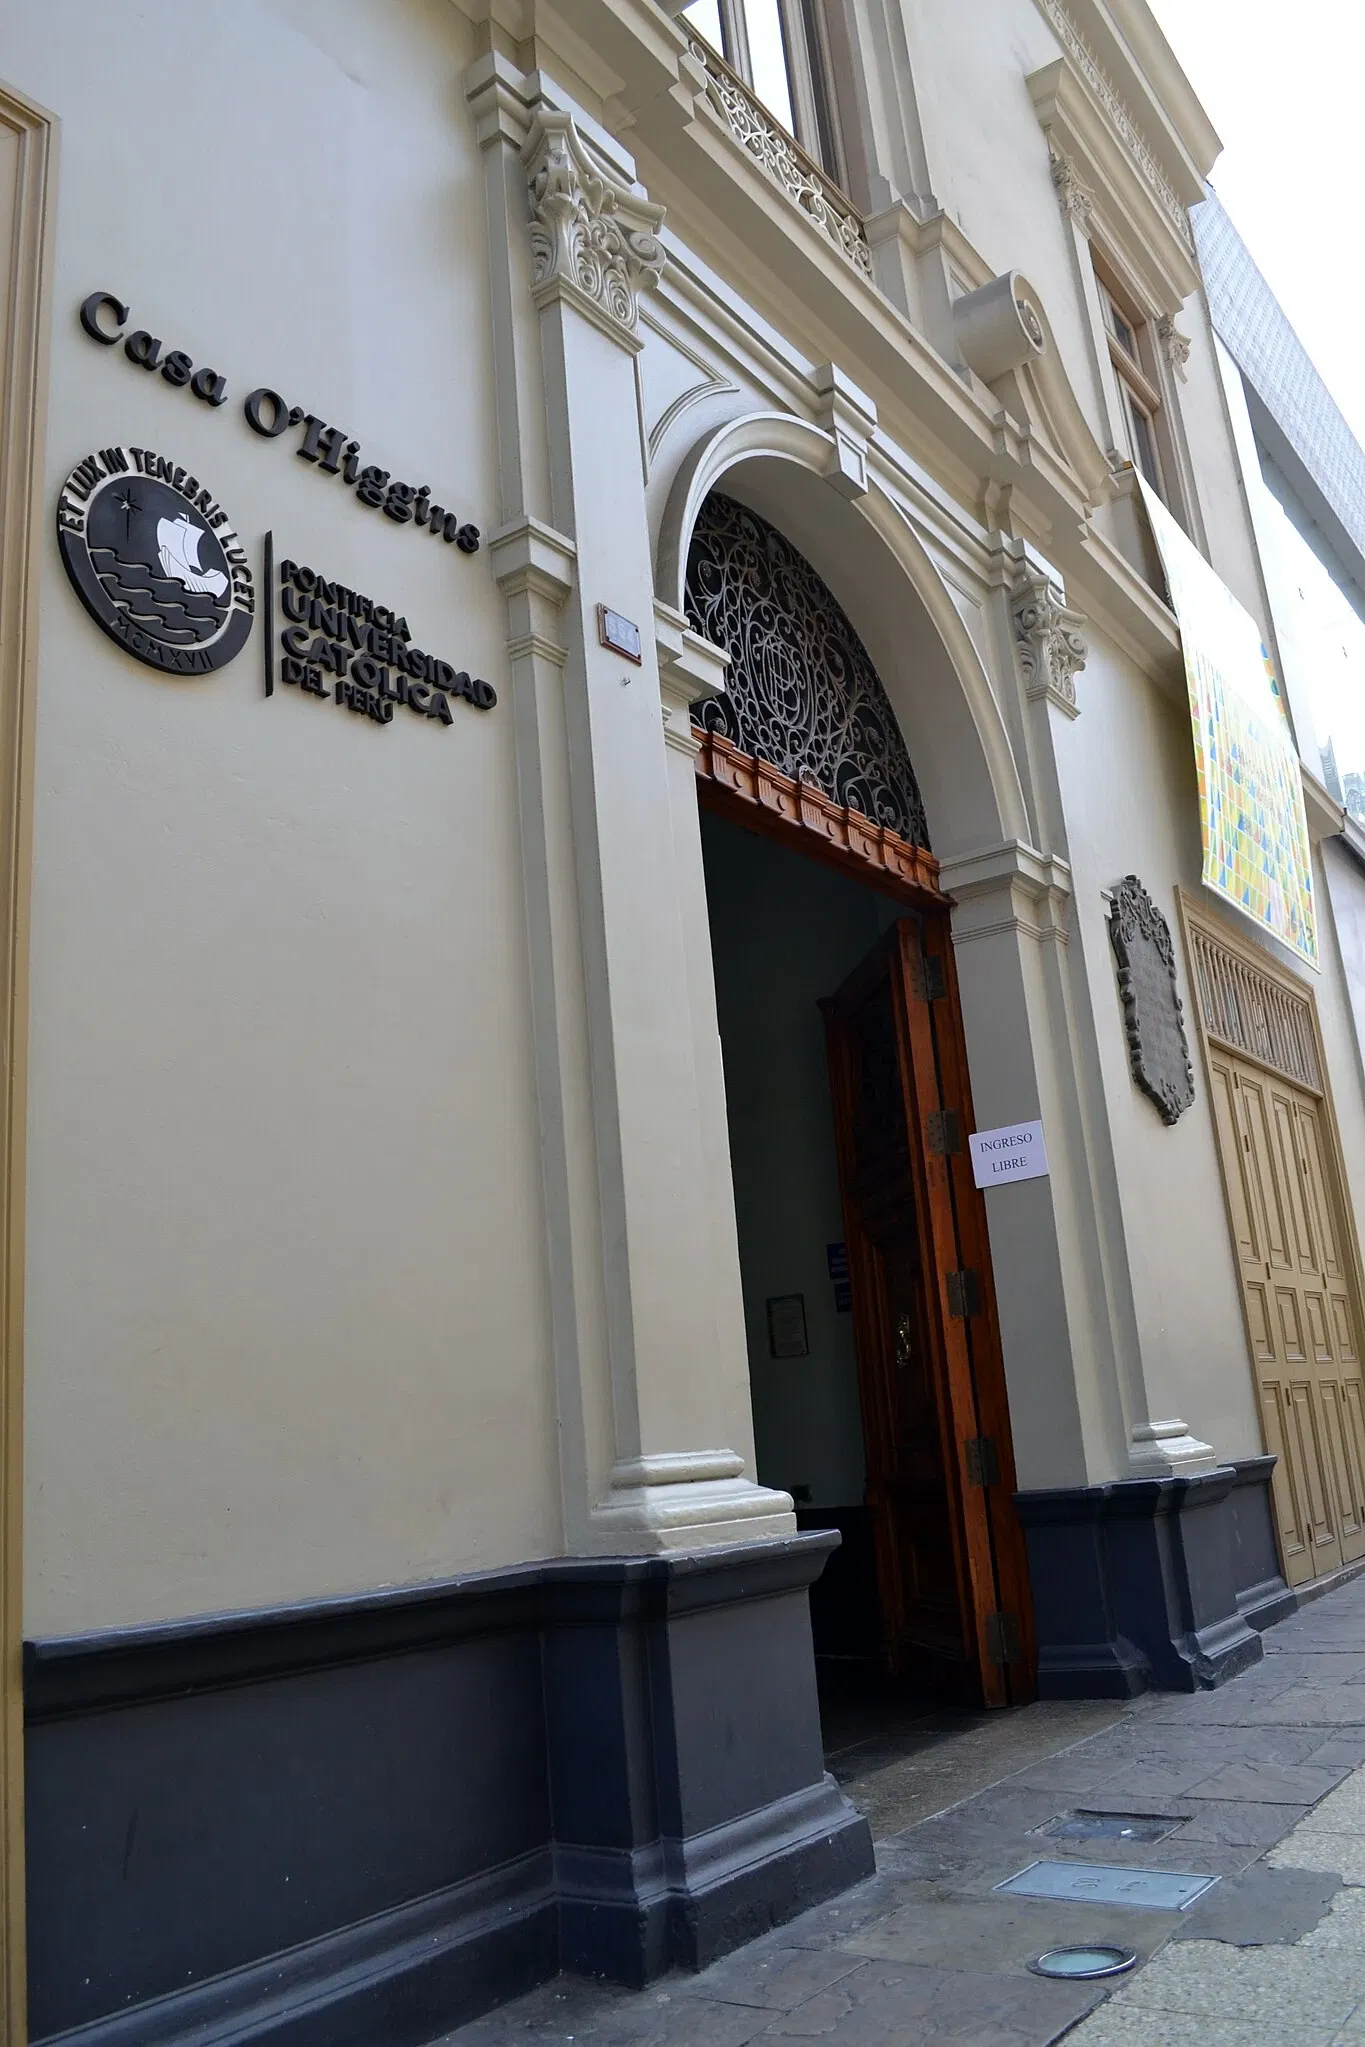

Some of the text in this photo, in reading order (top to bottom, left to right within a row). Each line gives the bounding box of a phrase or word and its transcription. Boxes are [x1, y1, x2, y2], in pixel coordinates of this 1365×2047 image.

[80, 291, 481, 554] Casa O'Higgins
[59, 447, 255, 613] ET LUX IN TENEBRIS LUCET
[117, 615, 213, 669] MCMXVII
[281, 559, 412, 643] PONTIFICIA
[281, 586, 497, 710] UNIVERSIDAD
[281, 626, 454, 726] CATÓLICA
[281, 657, 394, 725] DEL PERÚ
[980, 1132, 1033, 1152] INGRESO
[992, 1156, 1028, 1173] LIBRE
